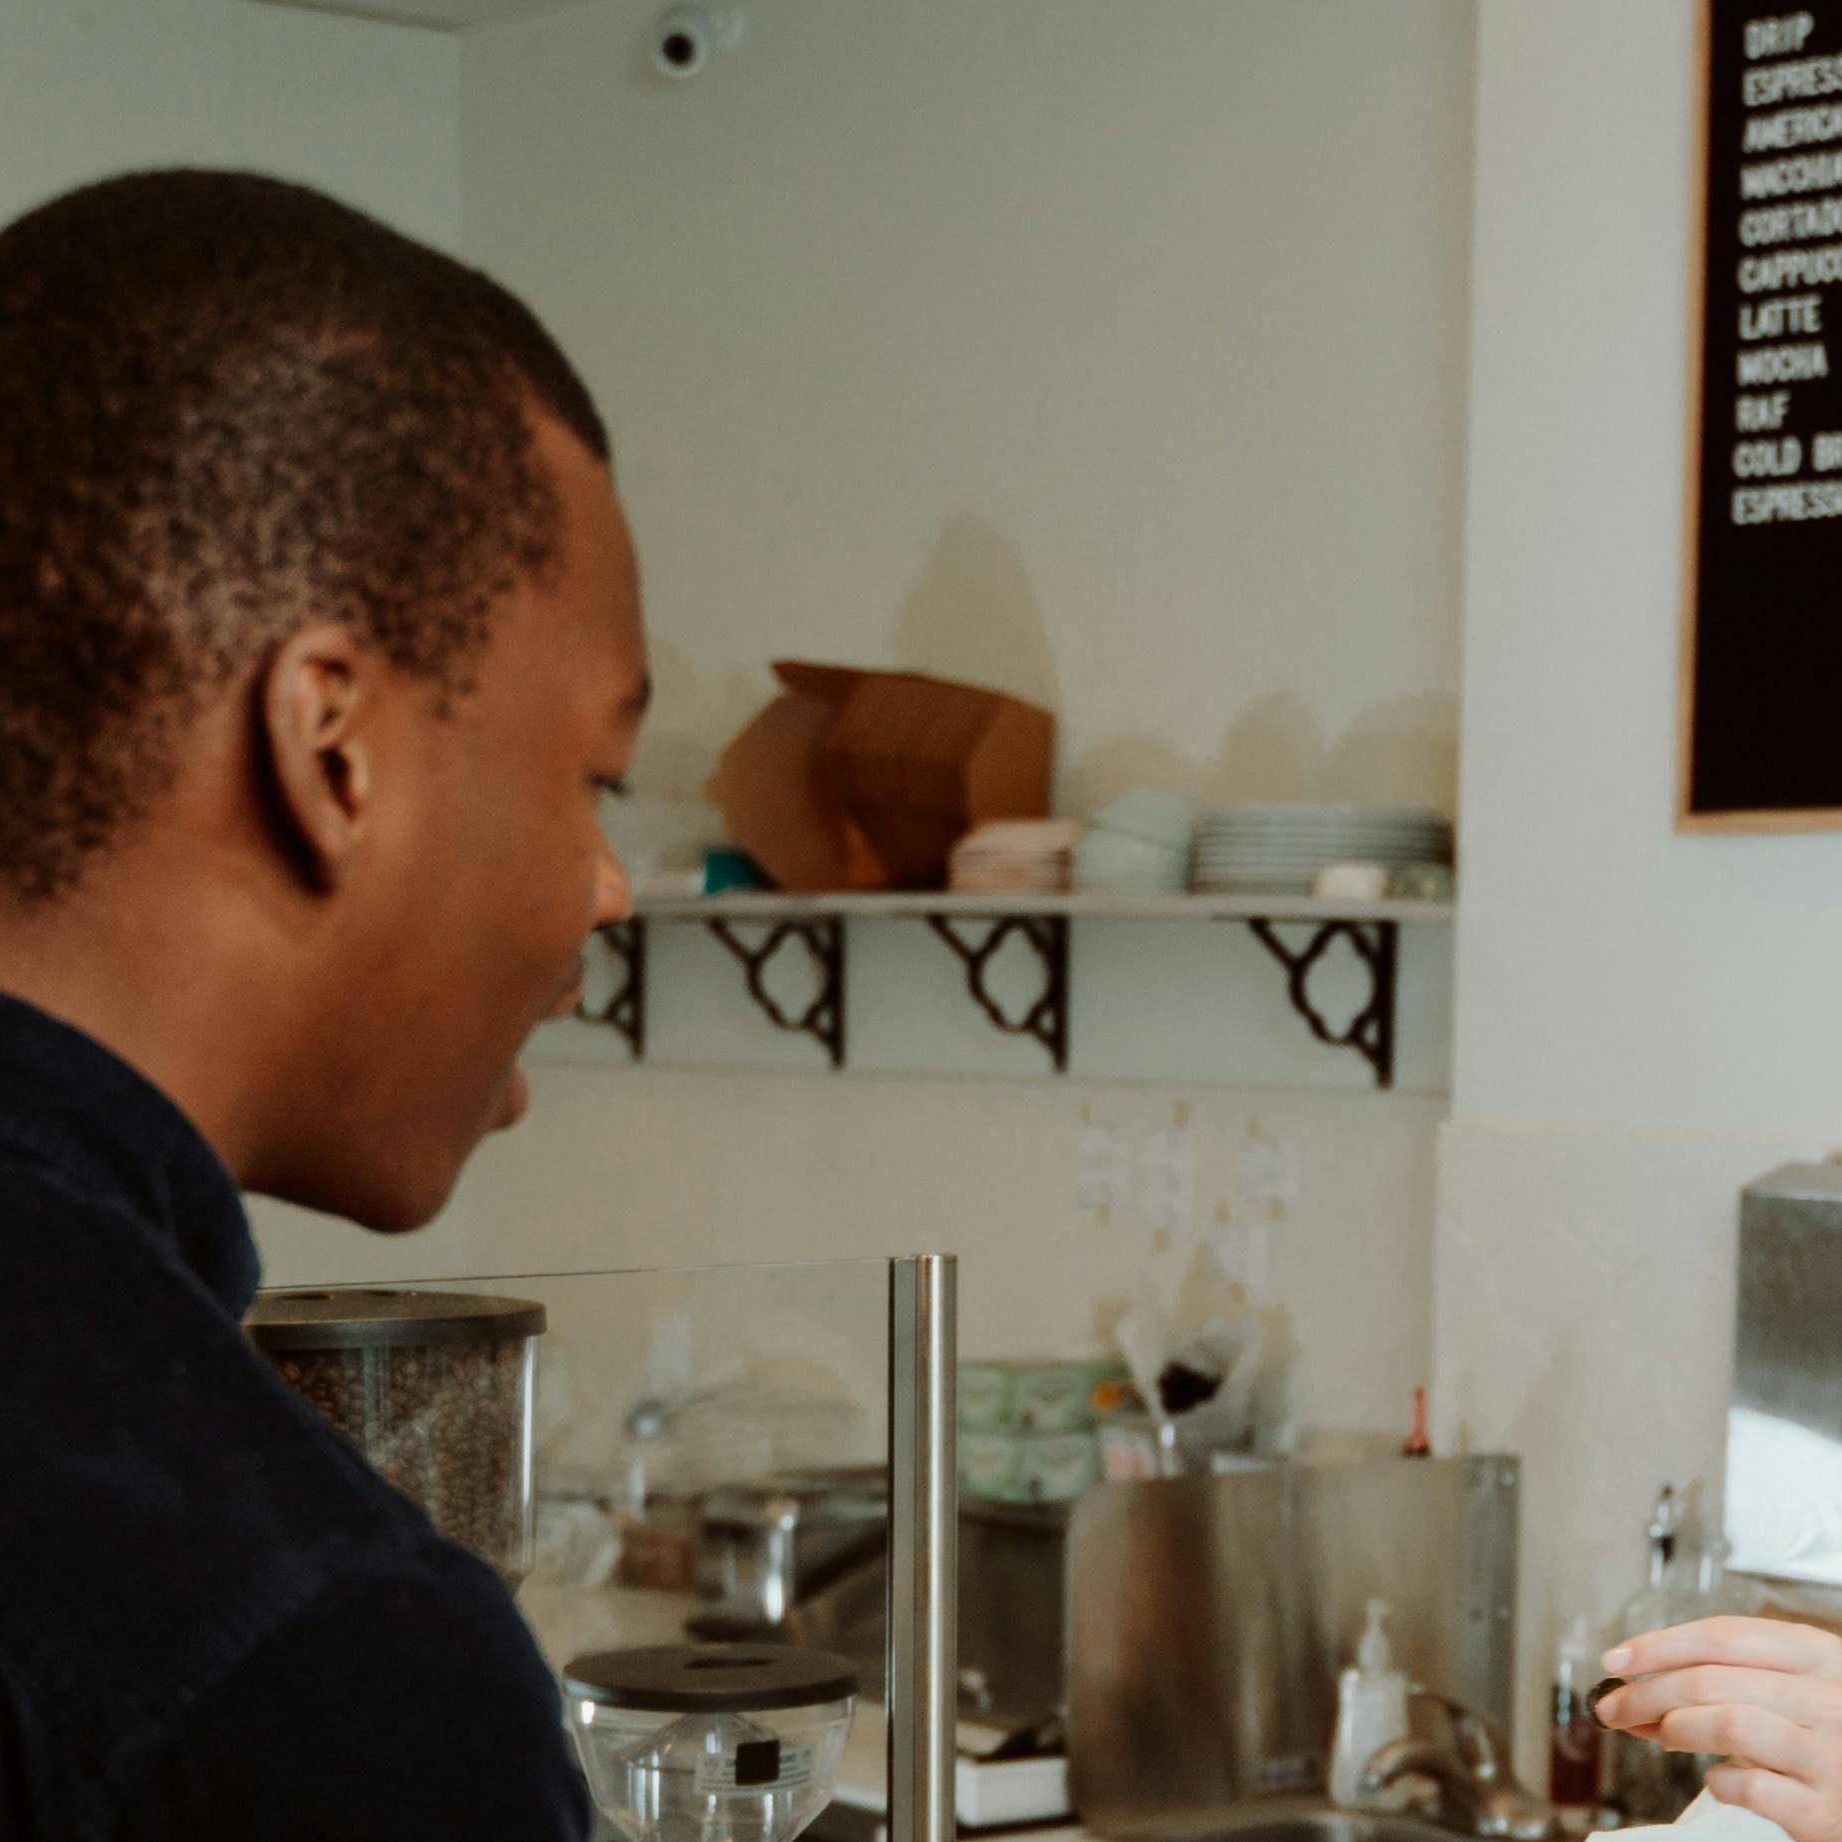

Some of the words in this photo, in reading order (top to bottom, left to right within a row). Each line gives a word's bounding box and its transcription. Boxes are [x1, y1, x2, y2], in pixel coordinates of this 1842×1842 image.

[1740, 294, 1821, 339] LATTE
[1738, 342, 1828, 385] MOCHA
[1733, 436, 1802, 477] COLD
